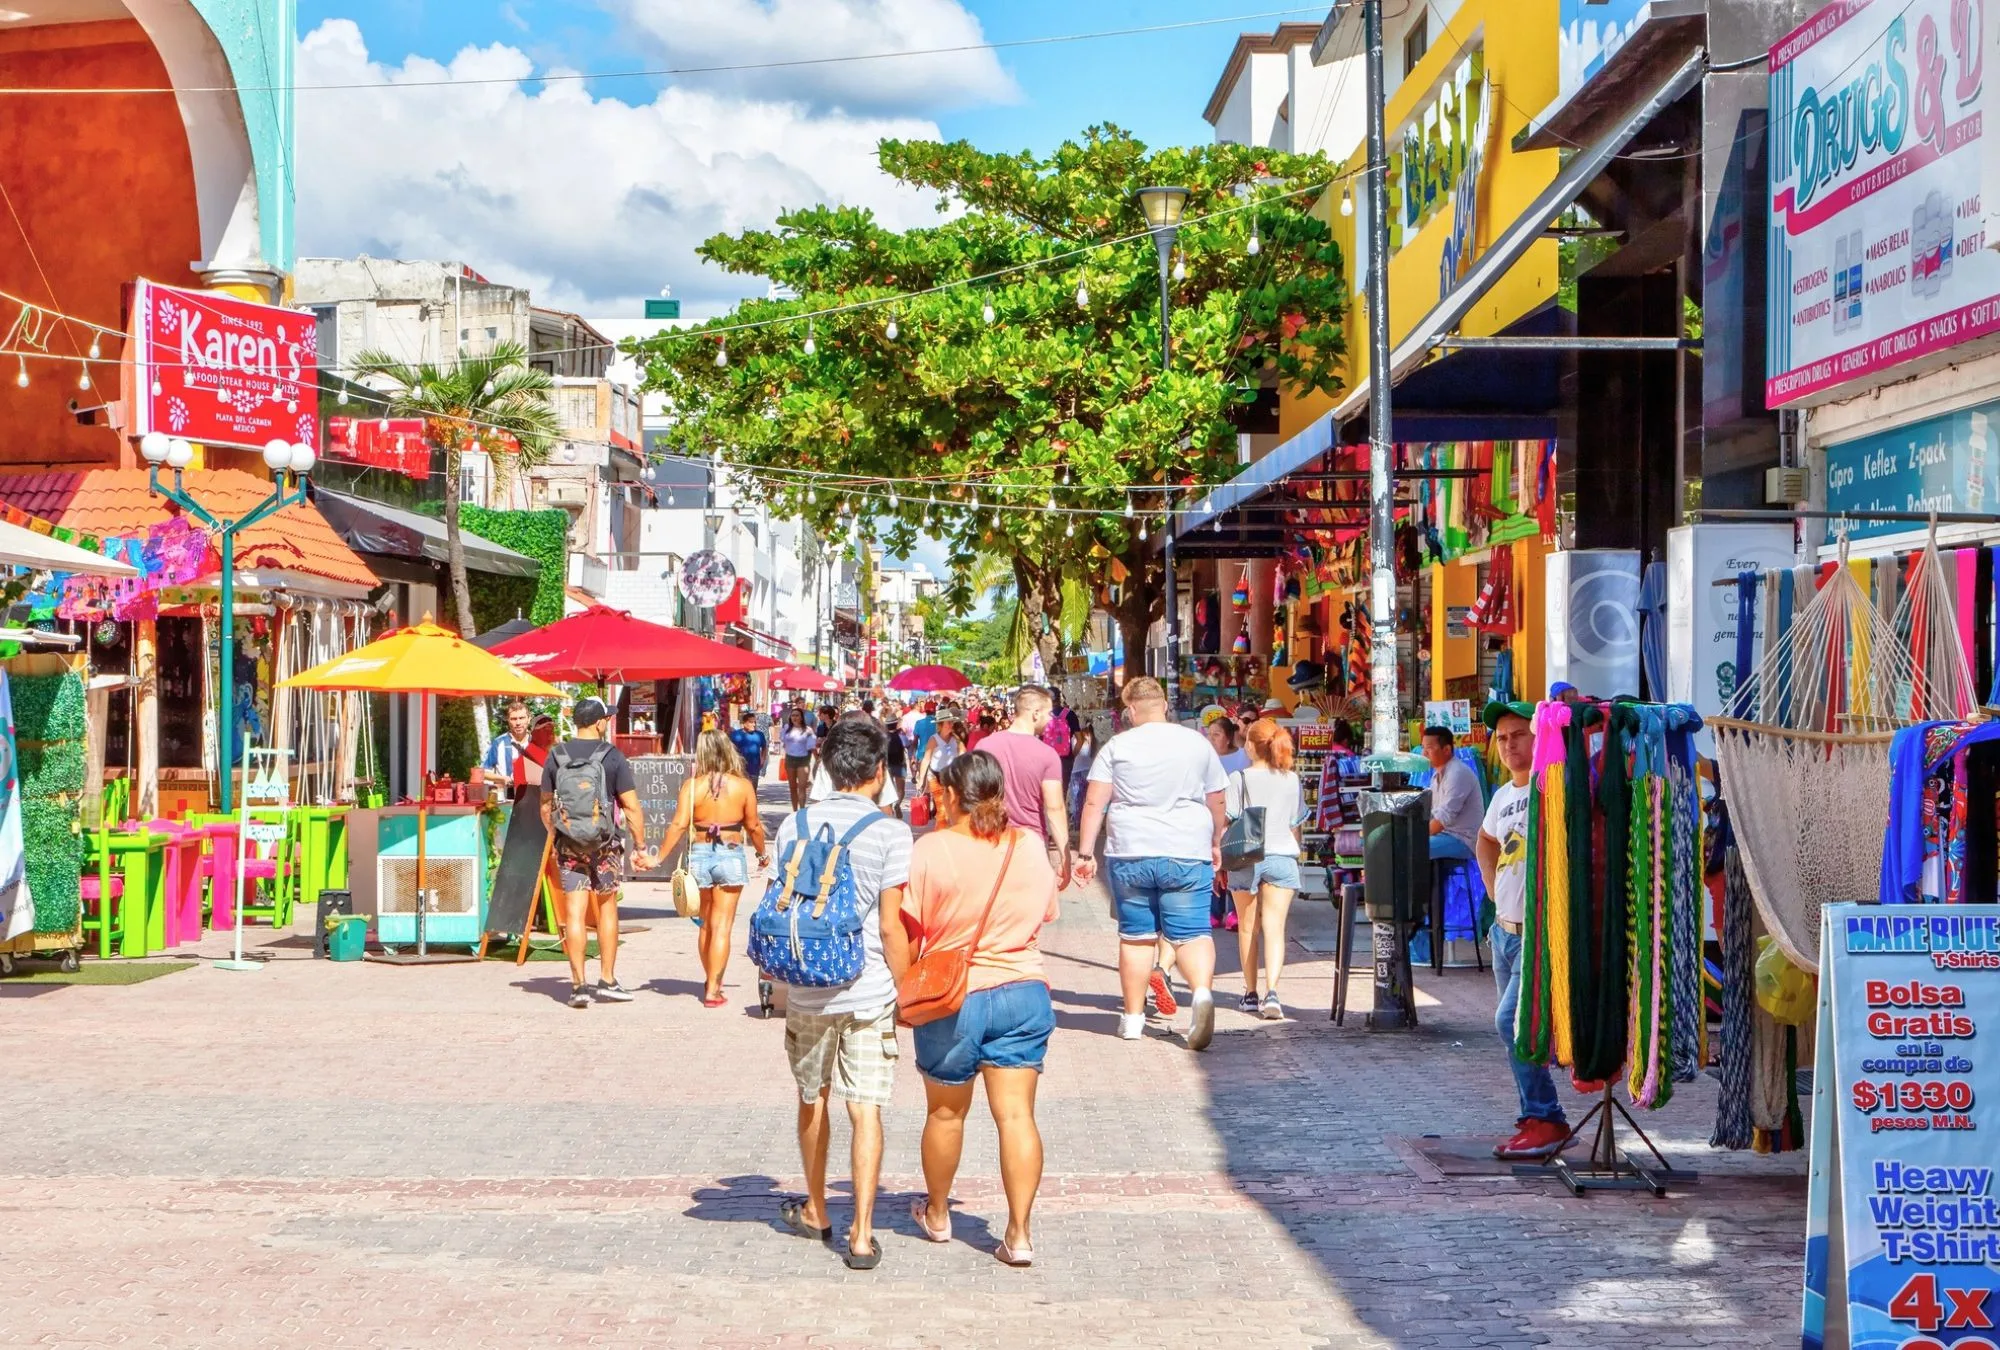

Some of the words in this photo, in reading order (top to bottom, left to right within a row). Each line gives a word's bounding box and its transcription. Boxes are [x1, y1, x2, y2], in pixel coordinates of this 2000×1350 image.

[1778, 26, 1815, 65] PRESCRIPTION
[1815, 10, 1836, 38] DRUGS
[1794, 13, 1909, 210] DRUGS
[1914, 14, 1946, 154] &
[1851, 157, 1908, 201] CONVENIENCE
[1962, 194, 1980, 219] VIAG
[1869, 238, 1888, 263] MASS
[1888, 228, 1910, 253] RELAX
[1961, 233, 1979, 258] DIET
[1796, 266, 1828, 296] ESTROGENS
[1869, 265, 1907, 296] ANABOLICS
[221, 315, 244, 328] SINCE
[1795, 299, 1831, 326] ANTIBIOTICS
[180, 308, 301, 382] Karen's
[1774, 371, 1811, 396] PRESCRIPTION
[1811, 362, 1832, 380] DRUGS
[1841, 347, 1869, 373] GENERICS
[1879, 337, 1893, 359] OTC
[1893, 328, 1917, 354] DRUGS
[1929, 314, 1958, 342] SNACKS
[1971, 303, 1991, 328] SOFT
[183, 370, 218, 385] SAFOOD
[221, 377, 243, 387] STEAK
[246, 381, 270, 391] HOUSE
[235, 415, 246, 424] DEL
[248, 417, 272, 427] CARMEN
[1829, 462, 1854, 495] Cipro
[1864, 448, 1897, 481] Keflex
[1908, 432, 1946, 475] Z-pack
[1726, 558, 1760, 570] Every
[633, 762, 684, 775] PARTIDO
[652, 775, 664, 785] DE
[646, 783, 669, 794] IDA
[650, 813, 666, 825] VS
[1846, 916, 1928, 953] MARE
[1930, 916, 2000, 953] BLUE
[1933, 953, 2000, 969] T-Shirts
[1865, 980, 1963, 1005] Bolsa
[1866, 1011, 1974, 1037] Gratis
[1896, 1045, 1919, 1055] en
[1924, 1042, 1942, 1055] la
[1862, 1058, 1942, 1074] compra
[1944, 1056, 1973, 1071] de
[1852, 1080, 1973, 1111] $1330
[1871, 1117, 1927, 1130] pesos
[1932, 1114, 1975, 1128] M.N.
[1873, 1160, 1991, 1196] Heavy
[1868, 1196, 1999, 1231] Weight
[1880, 1232, 2000, 1264] T-Shirt
[1888, 1272, 1994, 1331] 4x
